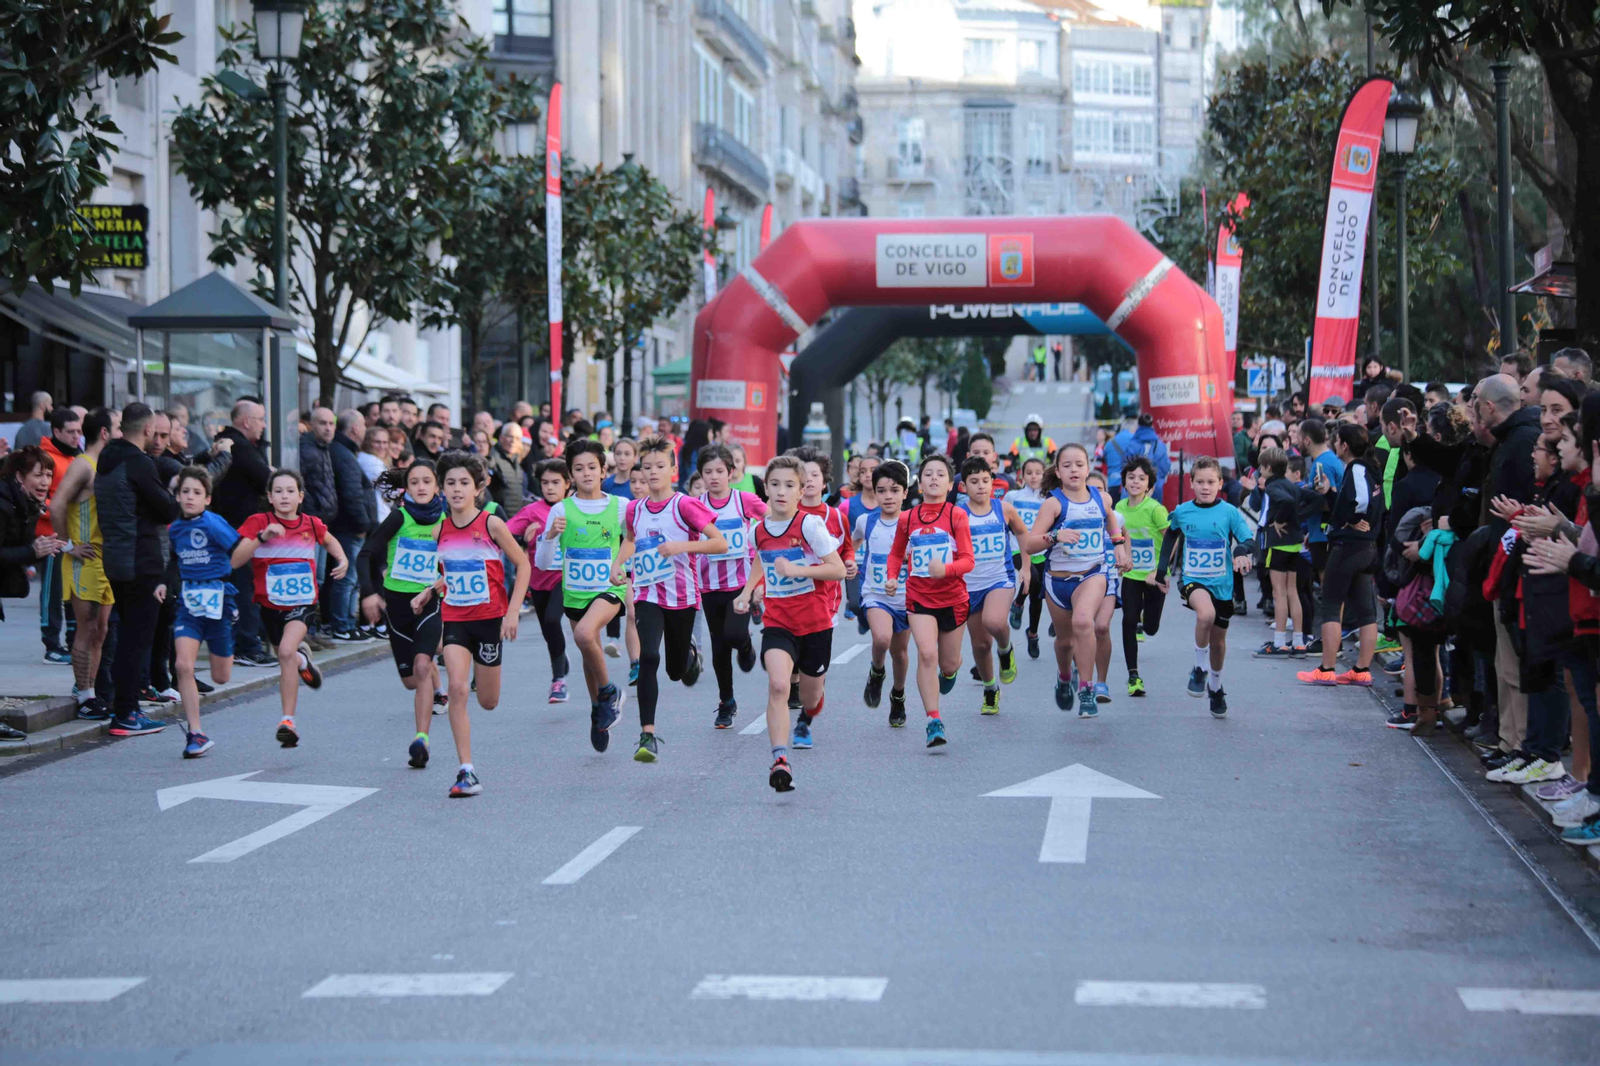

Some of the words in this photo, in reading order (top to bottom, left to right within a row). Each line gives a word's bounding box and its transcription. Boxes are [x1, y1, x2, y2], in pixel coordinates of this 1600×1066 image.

[1343, 215, 1359, 262] VIGO
[885, 244, 978, 259] CONCELLO
[1327, 200, 1348, 308] CONCELLO
[896, 262, 918, 276] DE
[925, 262, 967, 276] VIGO
[1339, 271, 1354, 296] DE
[1151, 381, 1195, 393] CONCELLO
[1156, 392, 1167, 400] DE
[1169, 390, 1191, 400] VIGO
[972, 535, 1004, 555] 515
[397, 552, 436, 574] 484
[634, 549, 672, 577] 502
[913, 546, 949, 569] 517
[1188, 551, 1224, 568] 525
[568, 561, 611, 582] 509
[873, 566, 909, 584] 59
[271, 576, 313, 597] 488
[445, 574, 486, 596] 516
[186, 592, 220, 610] 514
